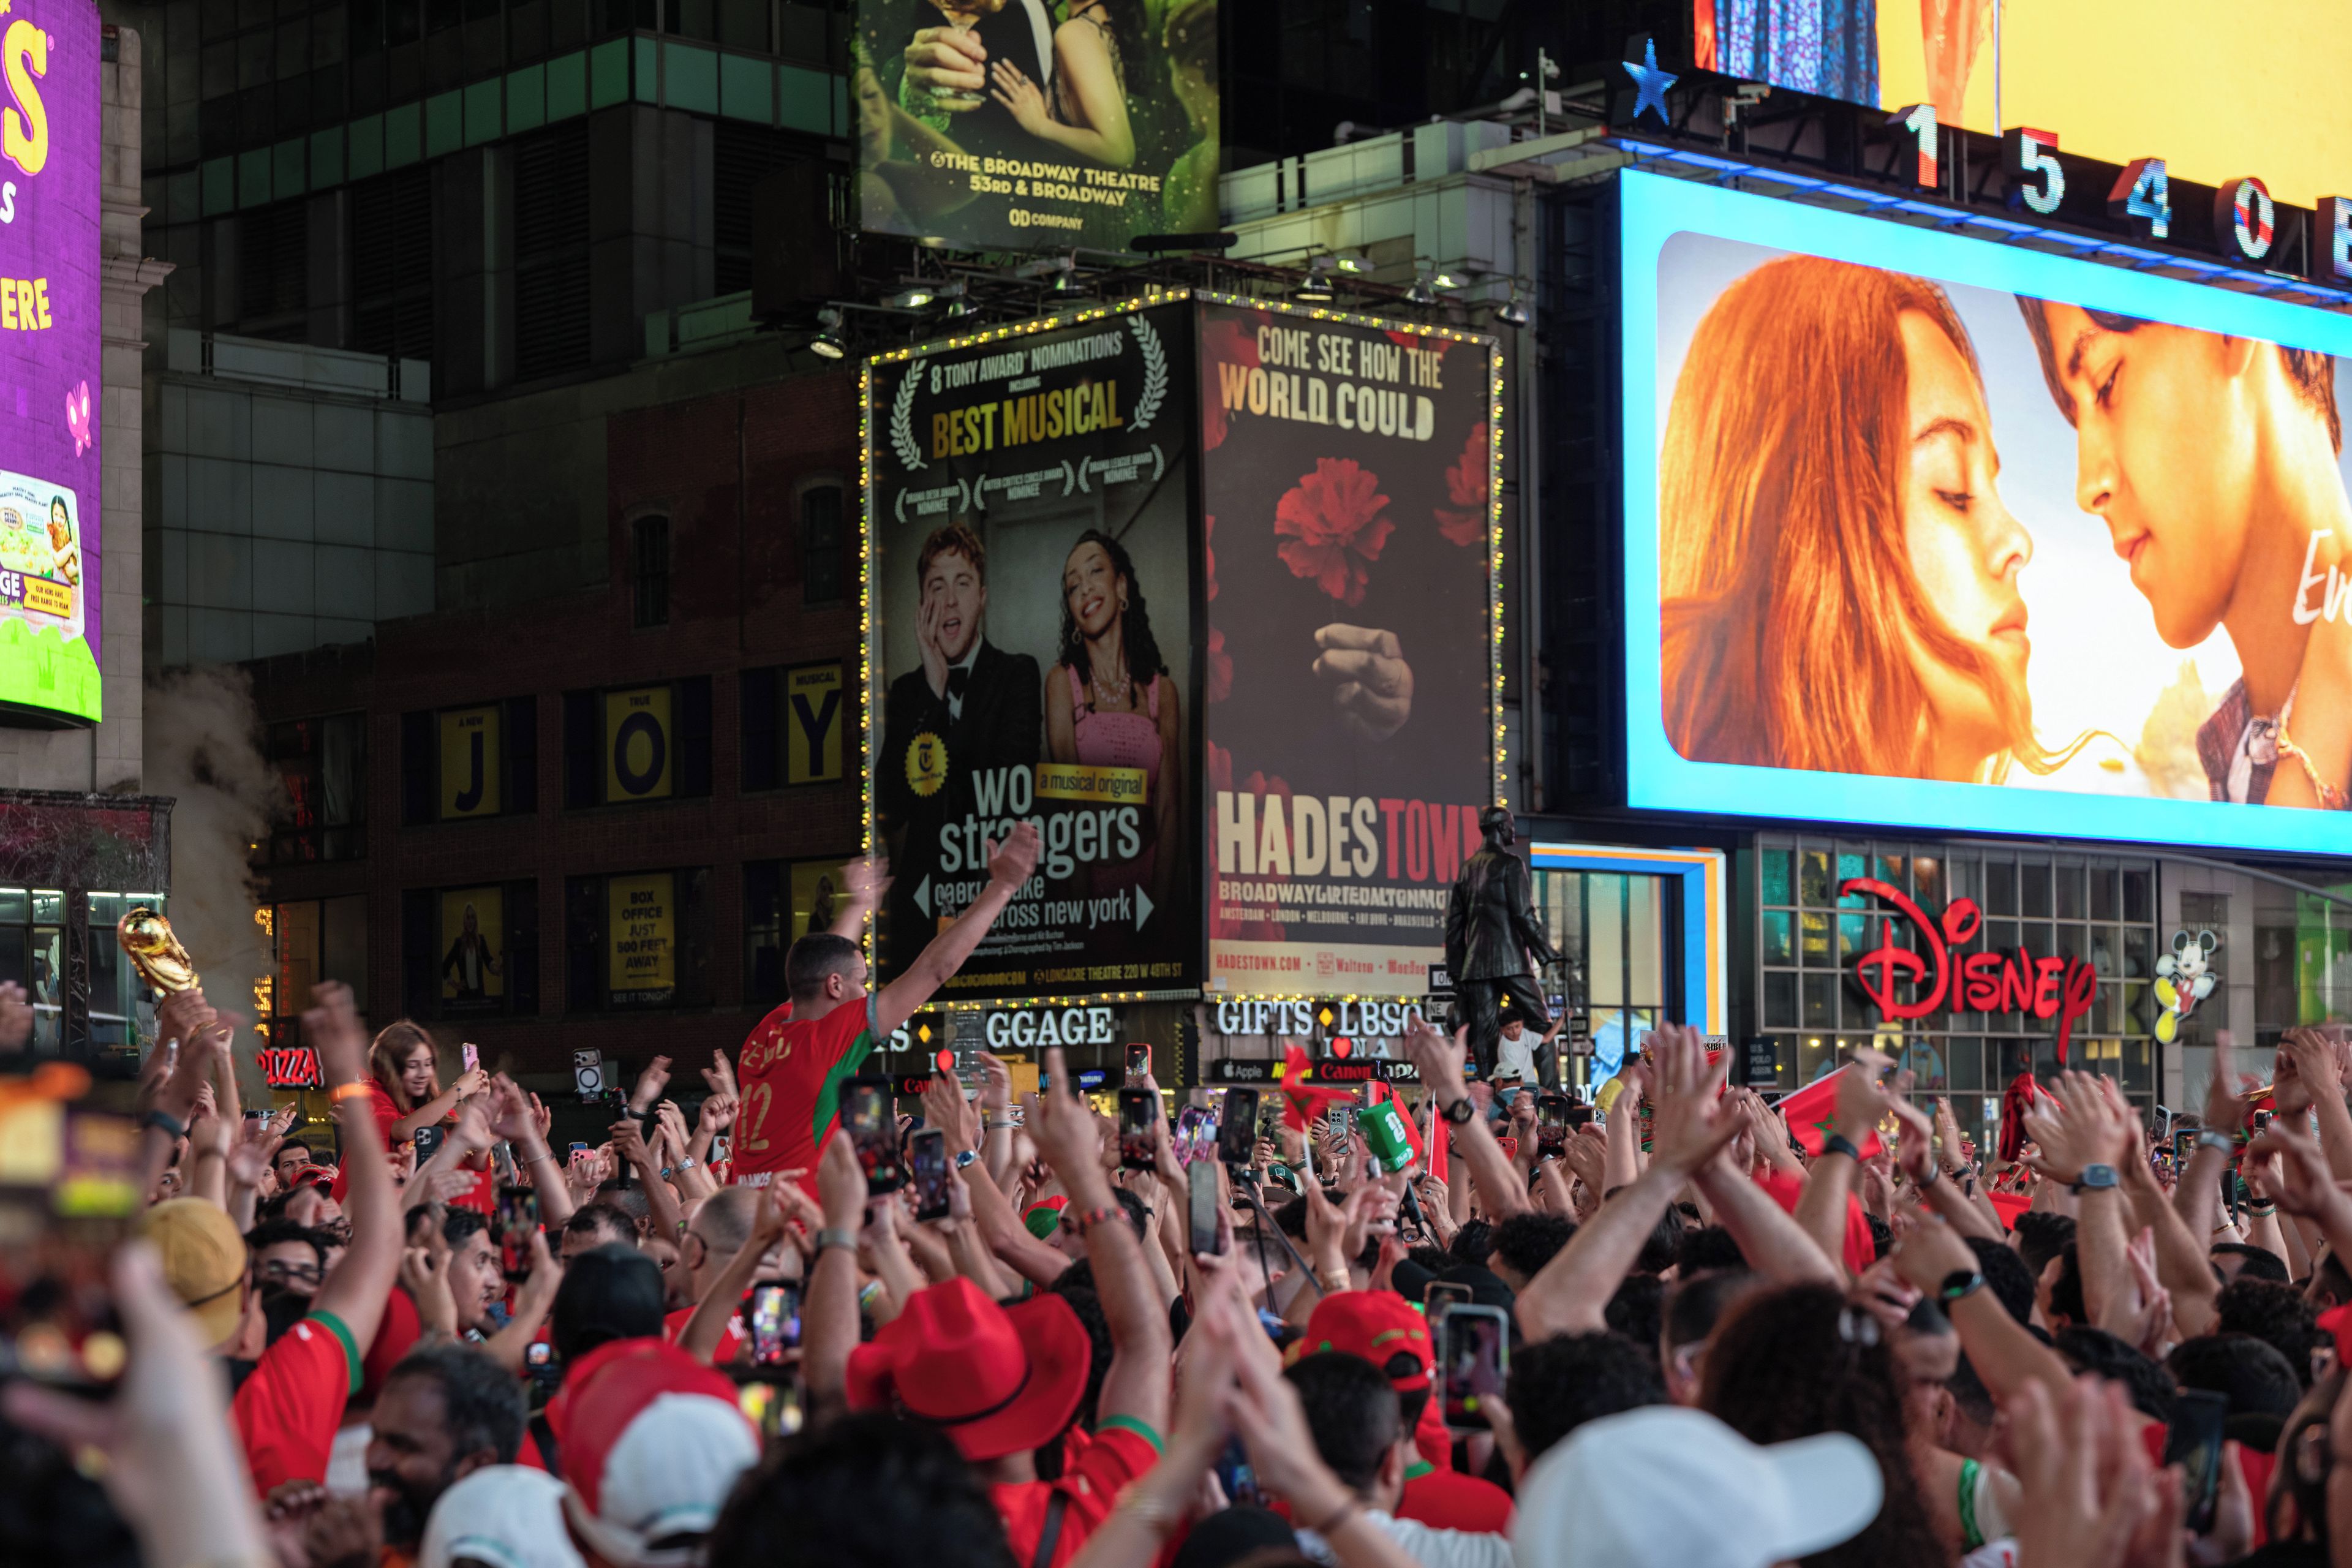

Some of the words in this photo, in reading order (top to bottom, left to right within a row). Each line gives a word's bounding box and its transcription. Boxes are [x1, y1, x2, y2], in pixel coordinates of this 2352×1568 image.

[944, 153, 980, 172] THE
[983, 157, 1082, 183] BROADWAY
[1083, 168, 1161, 192] THEATRE
[970, 175, 1012, 194] 53RD
[1014, 179, 1029, 196] &
[1032, 181, 1128, 206] BROADWAY
[1031, 214, 1084, 231] COMPANY
[931, 364, 942, 394] 8
[944, 360, 978, 388] TONY
[1031, 331, 1123, 372] NOMINATIONS
[1257, 325, 1311, 371] COME
[1317, 334, 1354, 377] SEE
[1359, 341, 1401, 383] HOW
[1406, 347, 1443, 390] THE
[1009, 376, 1041, 393] INCLUDING
[1218, 362, 1330, 426] WORLD
[1336, 382, 1434, 442] COULD
[933, 402, 998, 459] BEST
[1003, 380, 1124, 447] MUSICAL
[796, 670, 836, 687] MUSICAL
[628, 695, 651, 707] TRUE
[458, 718, 465, 728] A
[466, 715, 484, 727] NEW
[790, 689, 842, 777] Y
[614, 710, 666, 796] O
[454, 731, 484, 812] J
[1040, 774, 1047, 788] a
[1050, 771, 1096, 791] musical
[1098, 772, 1143, 797] original
[630, 890, 655, 905] BOX
[621, 906, 663, 921] OFFICE
[1044, 899, 1084, 925] new
[1088, 888, 1131, 930] york
[628, 922, 656, 937] JUST
[639, 938, 668, 952] FEET
[625, 955, 659, 970] AWAY
[1046, 967, 1087, 984] LONGACRE
[1087, 965, 1123, 981] THEATRE
[1123, 964, 1139, 979] 220
[1139, 964, 1148, 979] W
[1171, 962, 1183, 977] ST
[1216, 954, 1302, 971] HADESTOWN.COM
[612, 992, 627, 1004] SEE
[628, 992, 636, 1003] IT
[638, 989, 673, 1001] TONIGHT
[1218, 1001, 1314, 1036] GIFTS
[1235, 1065, 1263, 1079] Apple
[1271, 1061, 1313, 1079] Nin
[1321, 1063, 1373, 1080] Canon
[739, 1082, 772, 1150] 12
